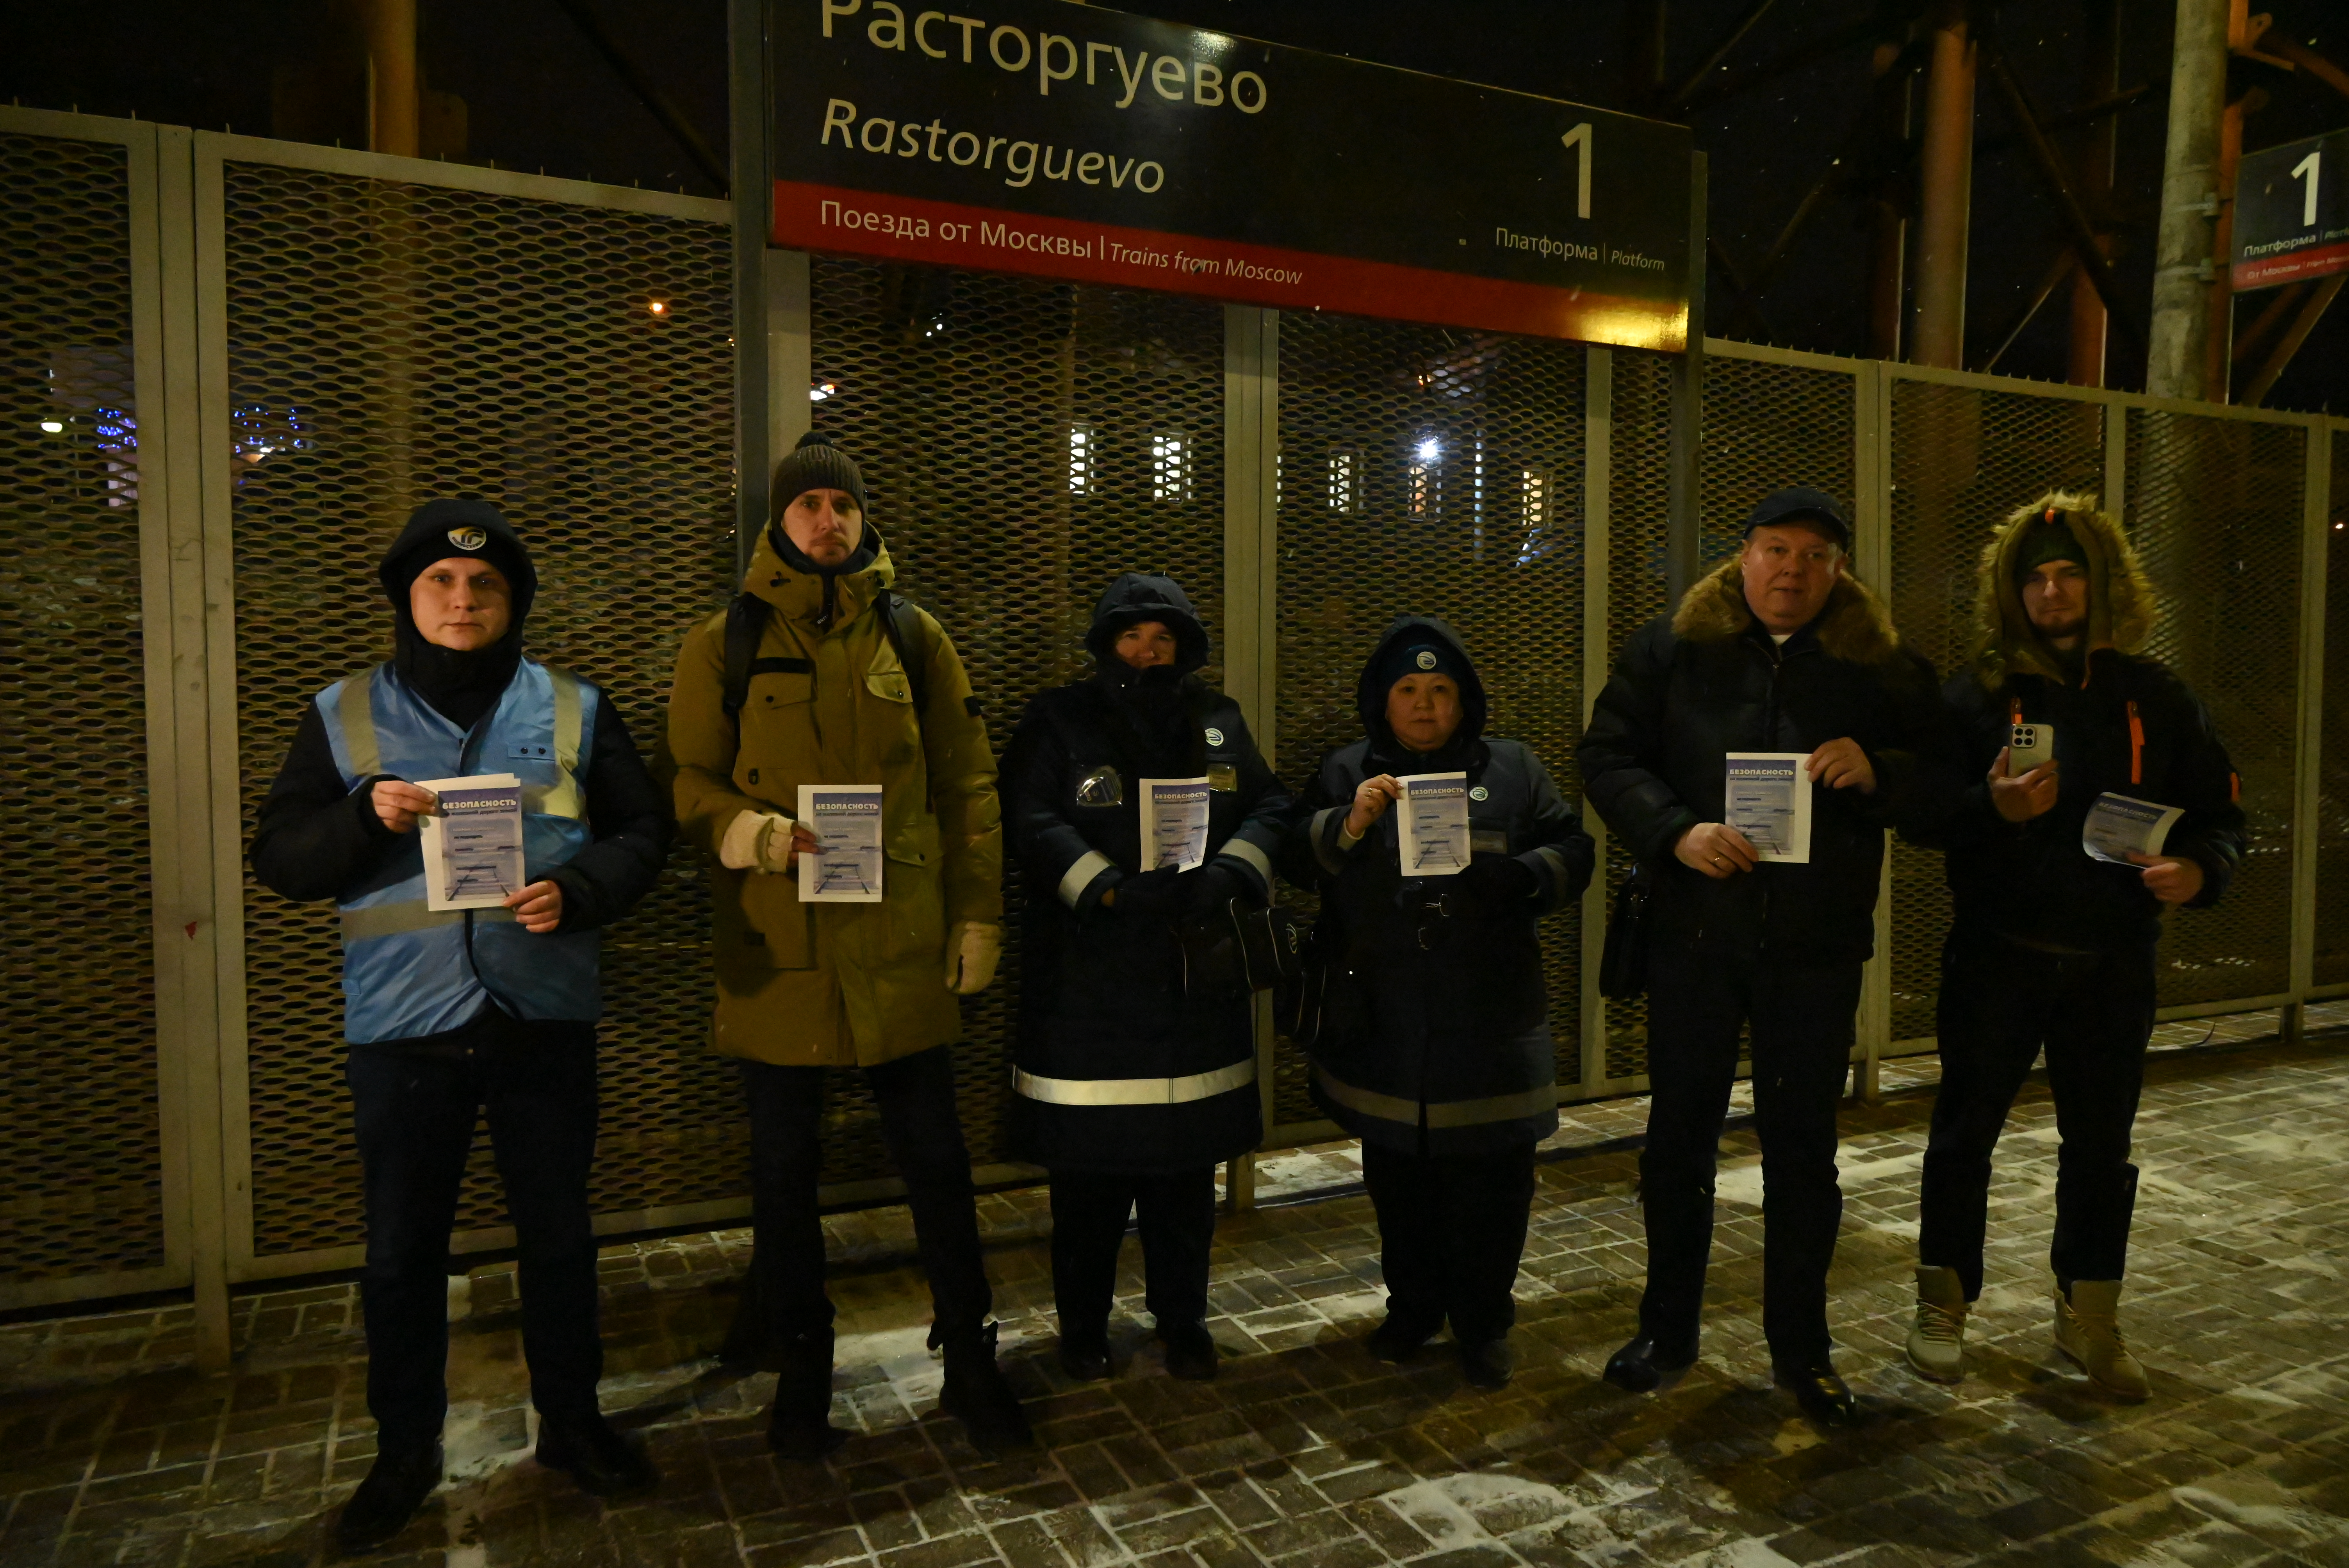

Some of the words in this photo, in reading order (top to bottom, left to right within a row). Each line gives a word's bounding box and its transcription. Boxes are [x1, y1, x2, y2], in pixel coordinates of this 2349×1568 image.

[822, 0, 1267, 114] Расторгуево
[821, 98, 1164, 193] Rastorguevo
[1561, 122, 1592, 219] 1
[2291, 151, 2320, 226] 1
[821, 200, 930, 240] Поезда
[939, 222, 971, 242] от
[981, 221, 1091, 258] Москвы
[1496, 227, 1598, 261] Платформа
[2244, 235, 2317, 257] Платформа
[1110, 243, 1169, 267] Trains
[1174, 251, 1219, 274] from
[1225, 258, 1303, 285] Moscow
[1611, 250, 1665, 271] Platform
[442, 799, 517, 809] БЕЗОПАСНОСТЬ
